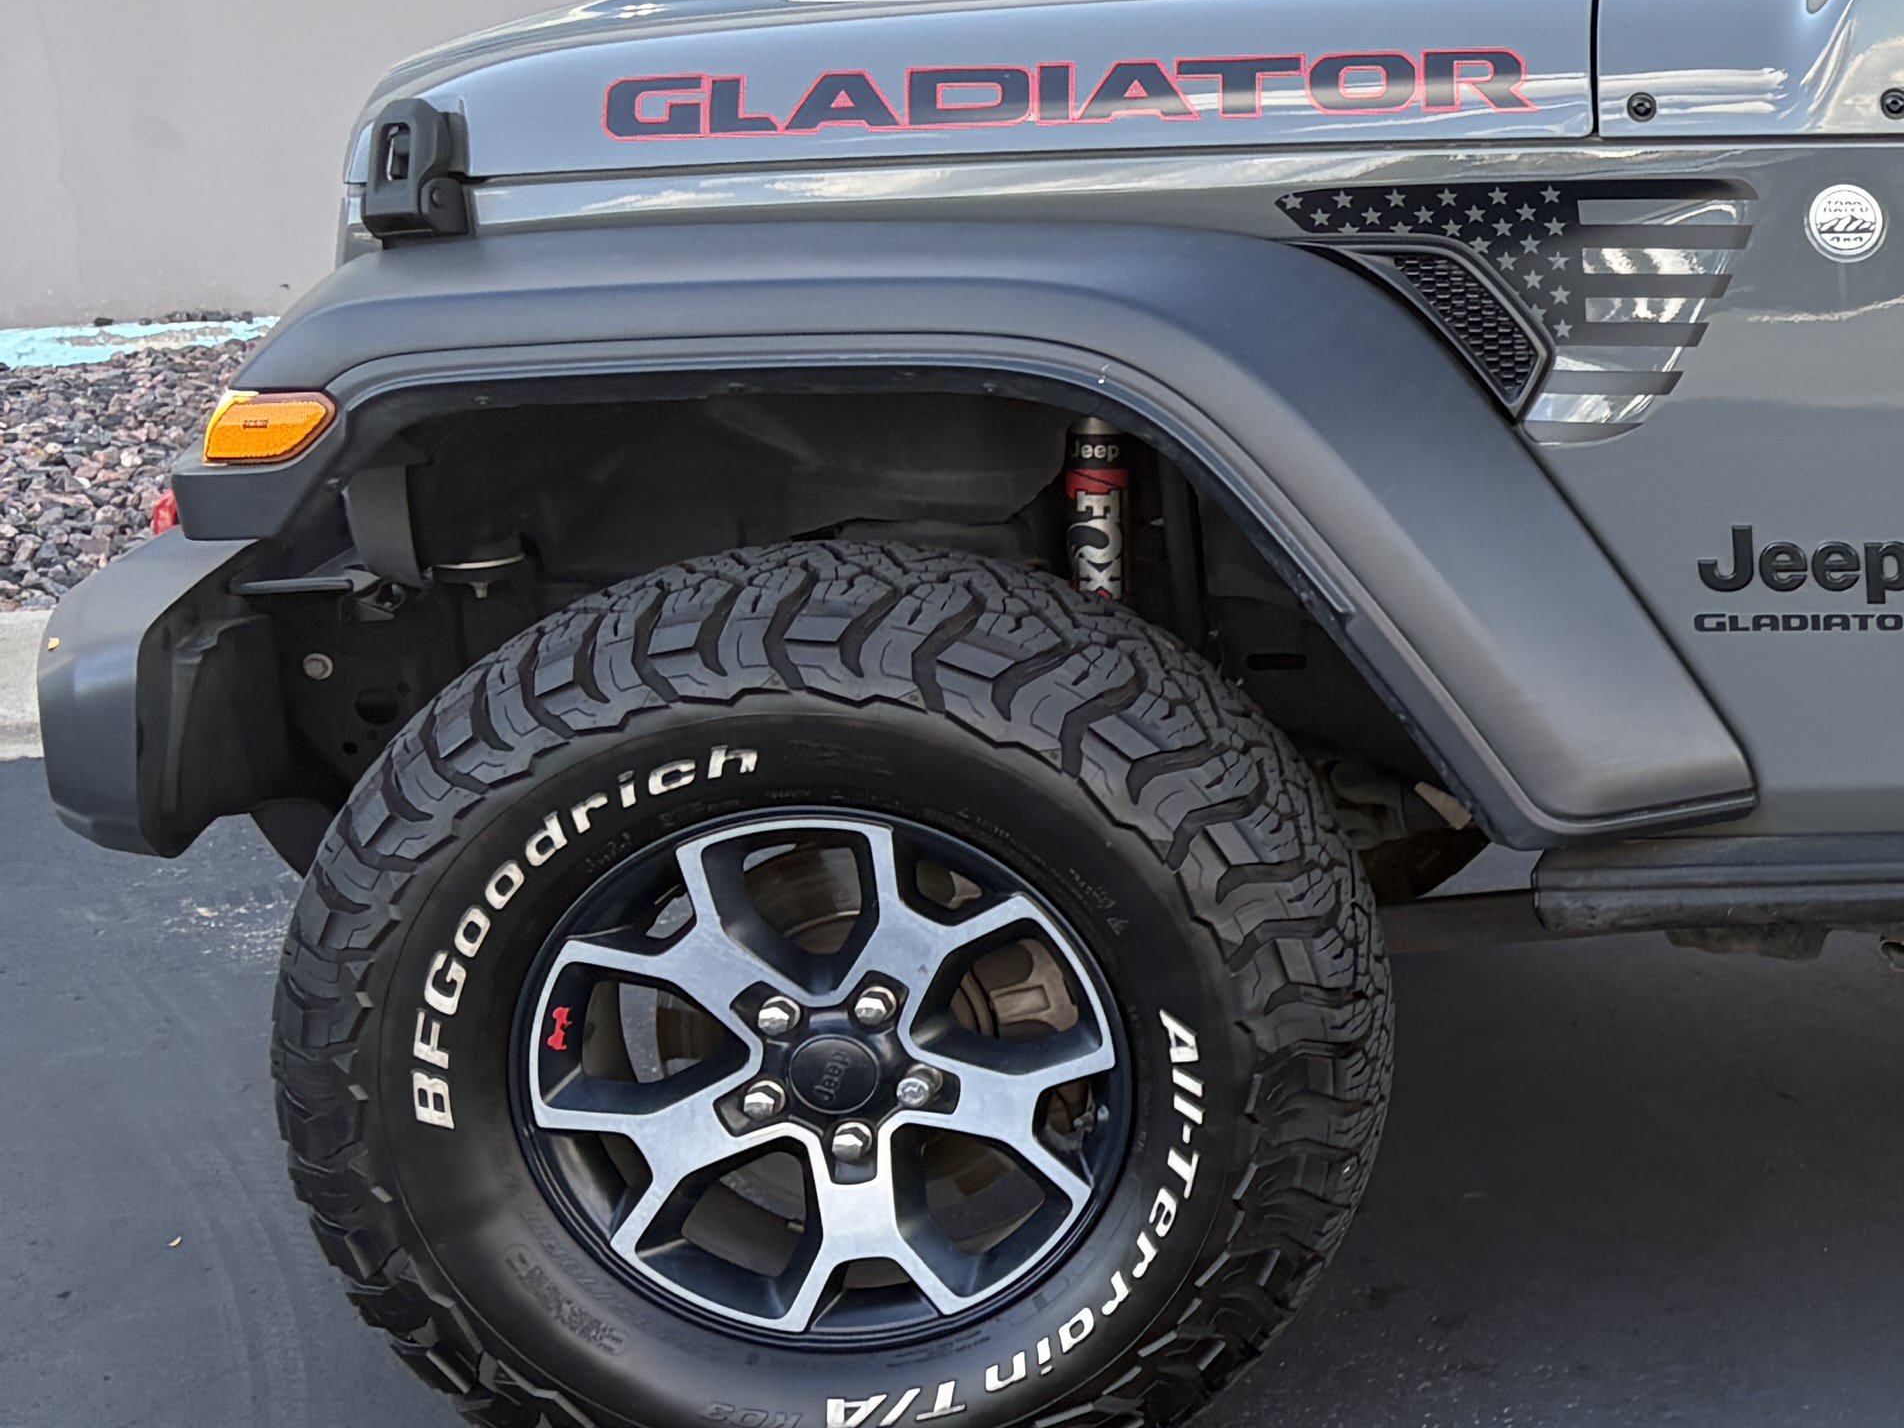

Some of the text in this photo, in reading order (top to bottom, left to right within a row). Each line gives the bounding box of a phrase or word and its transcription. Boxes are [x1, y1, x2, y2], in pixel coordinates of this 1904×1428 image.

[603, 47, 1541, 141] GLADIATOR
[1072, 443, 1121, 462] Jeep
[1066, 489, 1124, 601] FOX
[411, 744, 760, 1130] BFGoodrich
[984, 1008, 1206, 1394] All-Terrain
